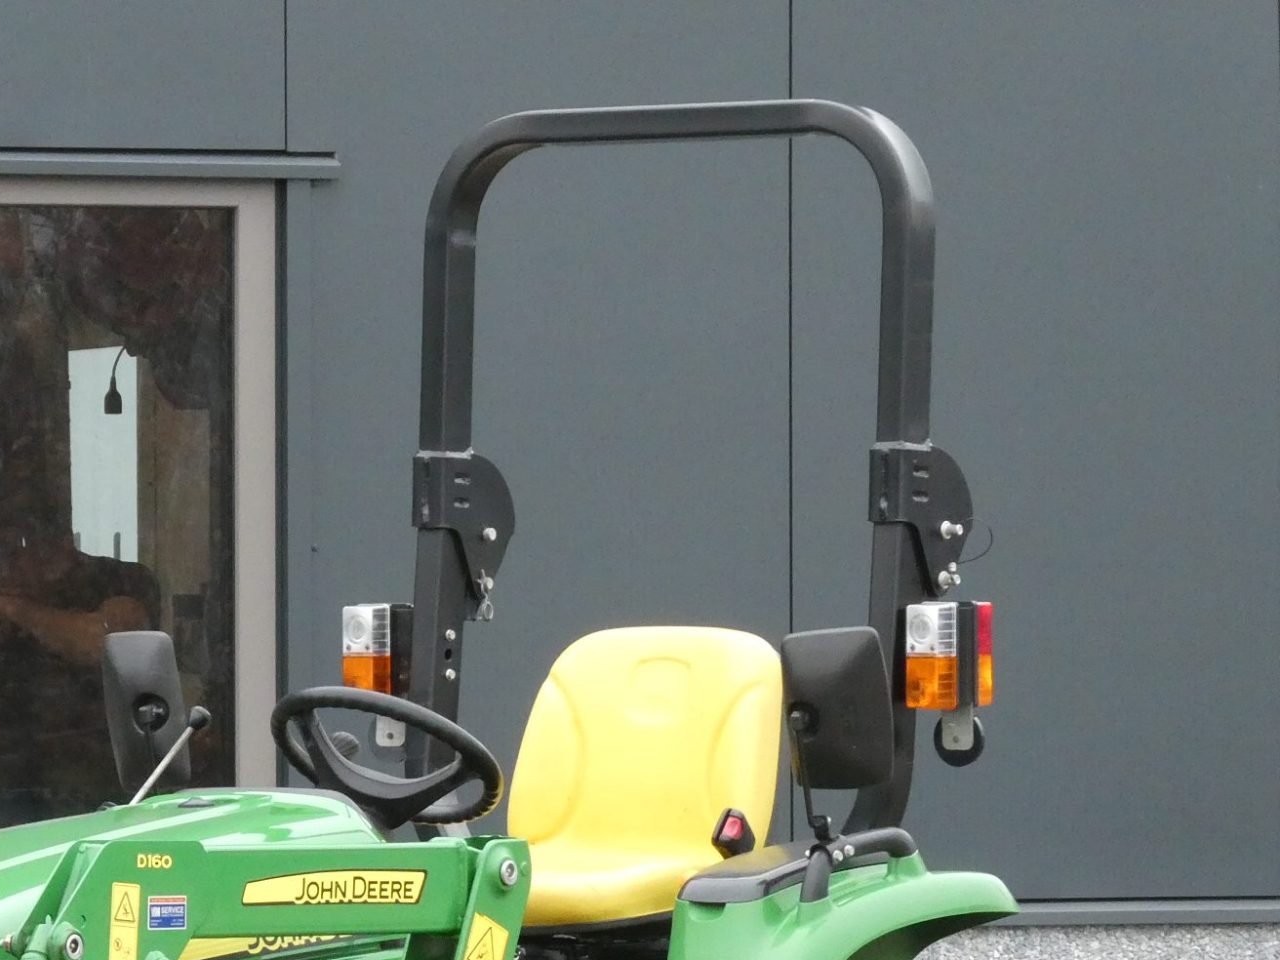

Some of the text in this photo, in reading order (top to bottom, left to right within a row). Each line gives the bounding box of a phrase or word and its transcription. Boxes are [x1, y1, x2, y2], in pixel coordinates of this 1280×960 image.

[137, 854, 173, 869] D160
[295, 876, 414, 901] JOHN DEERE
